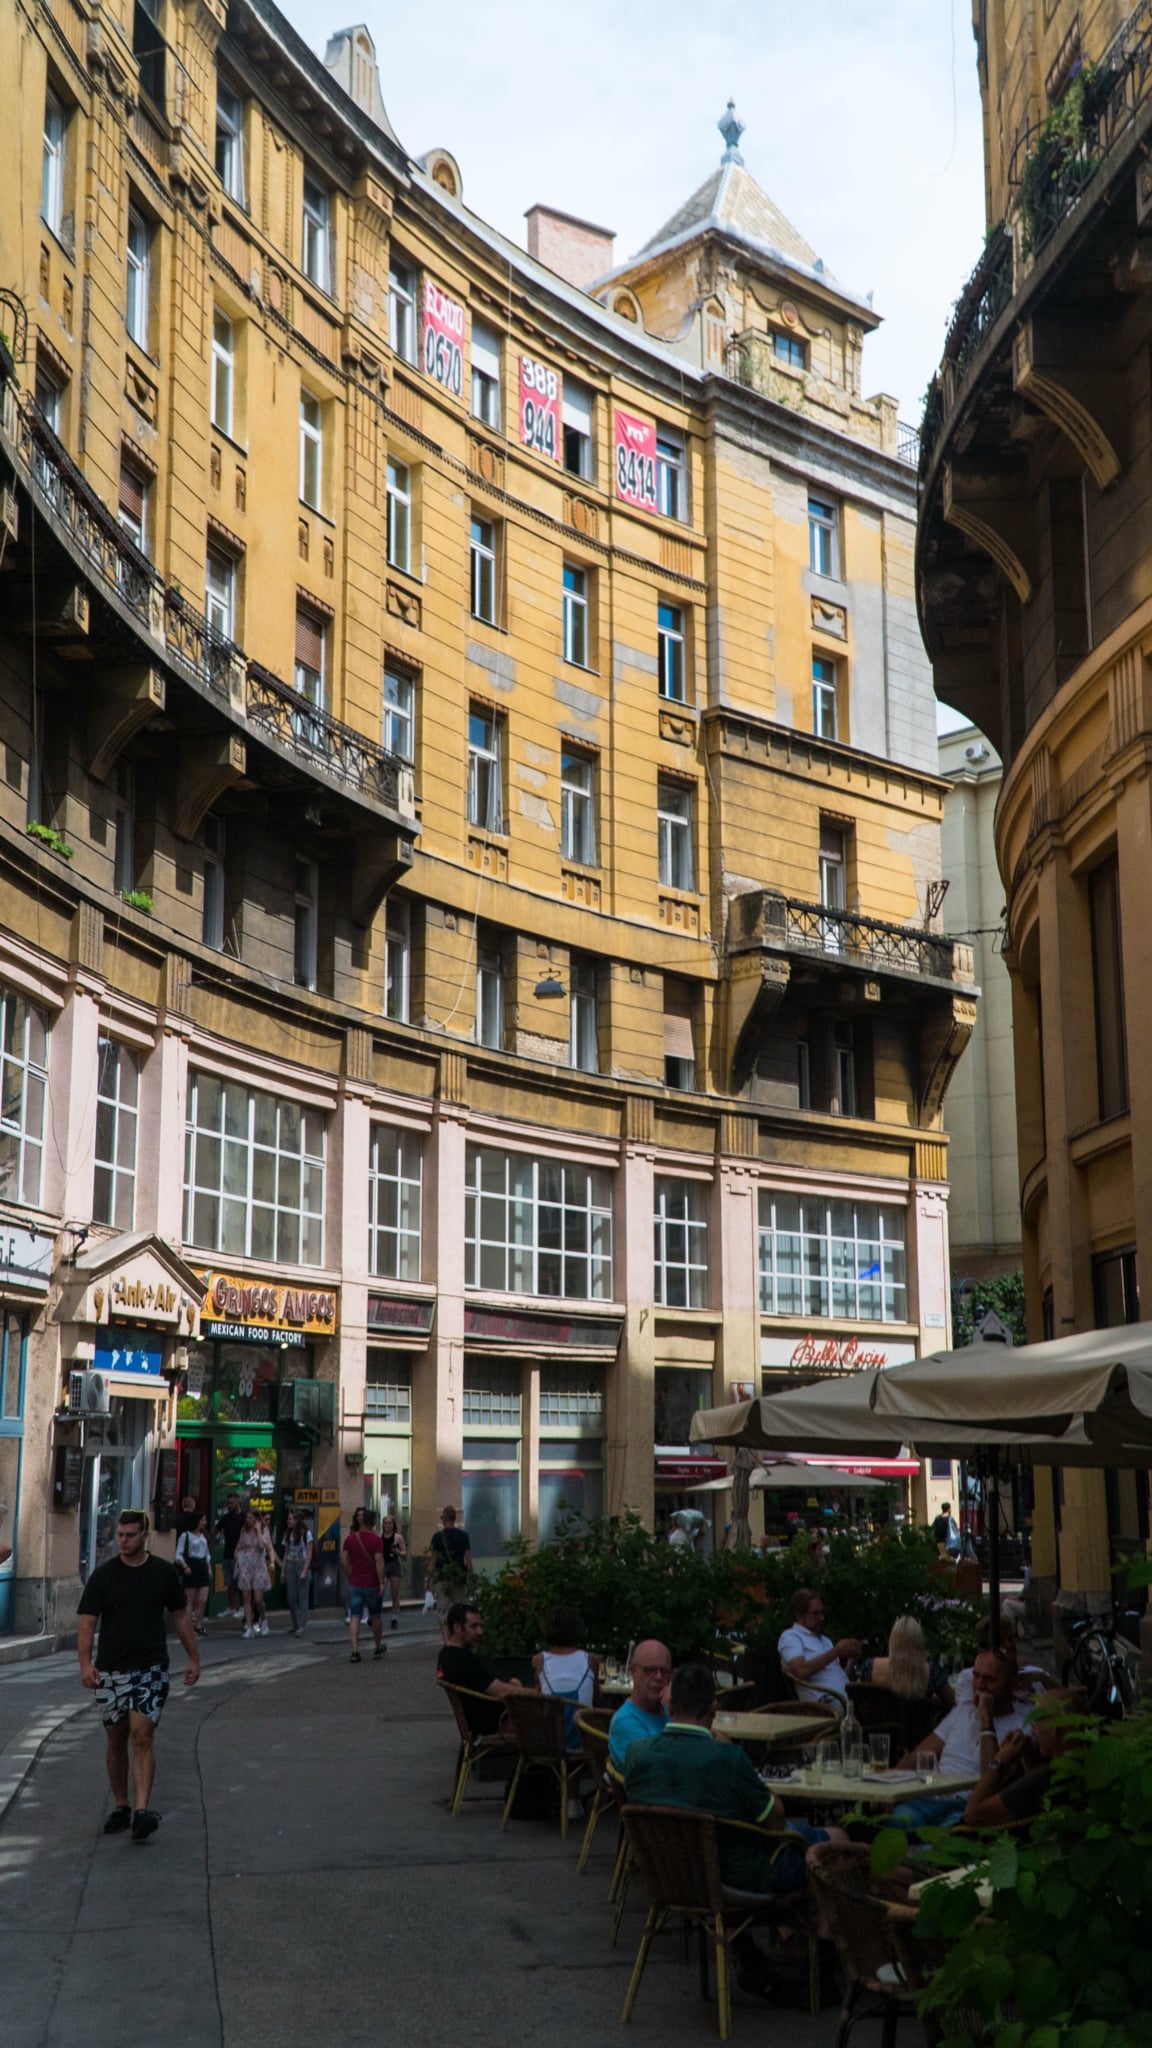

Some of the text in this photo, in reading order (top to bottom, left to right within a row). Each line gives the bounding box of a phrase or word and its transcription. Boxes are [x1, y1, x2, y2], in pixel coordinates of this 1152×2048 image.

[425, 325, 463, 398] 0670
[522, 355, 558, 400] 388
[524, 398, 556, 460] 944
[616, 443, 656, 505] 8414
[213, 1277, 278, 1316] GRINGOS
[280, 1289, 335, 1320] AMIGOS
[211, 1323, 303, 1344] MEXICAN FOOD FACTORY
[297, 1490, 319, 1500] ATM
[322, 1540, 336, 1552] ATM
